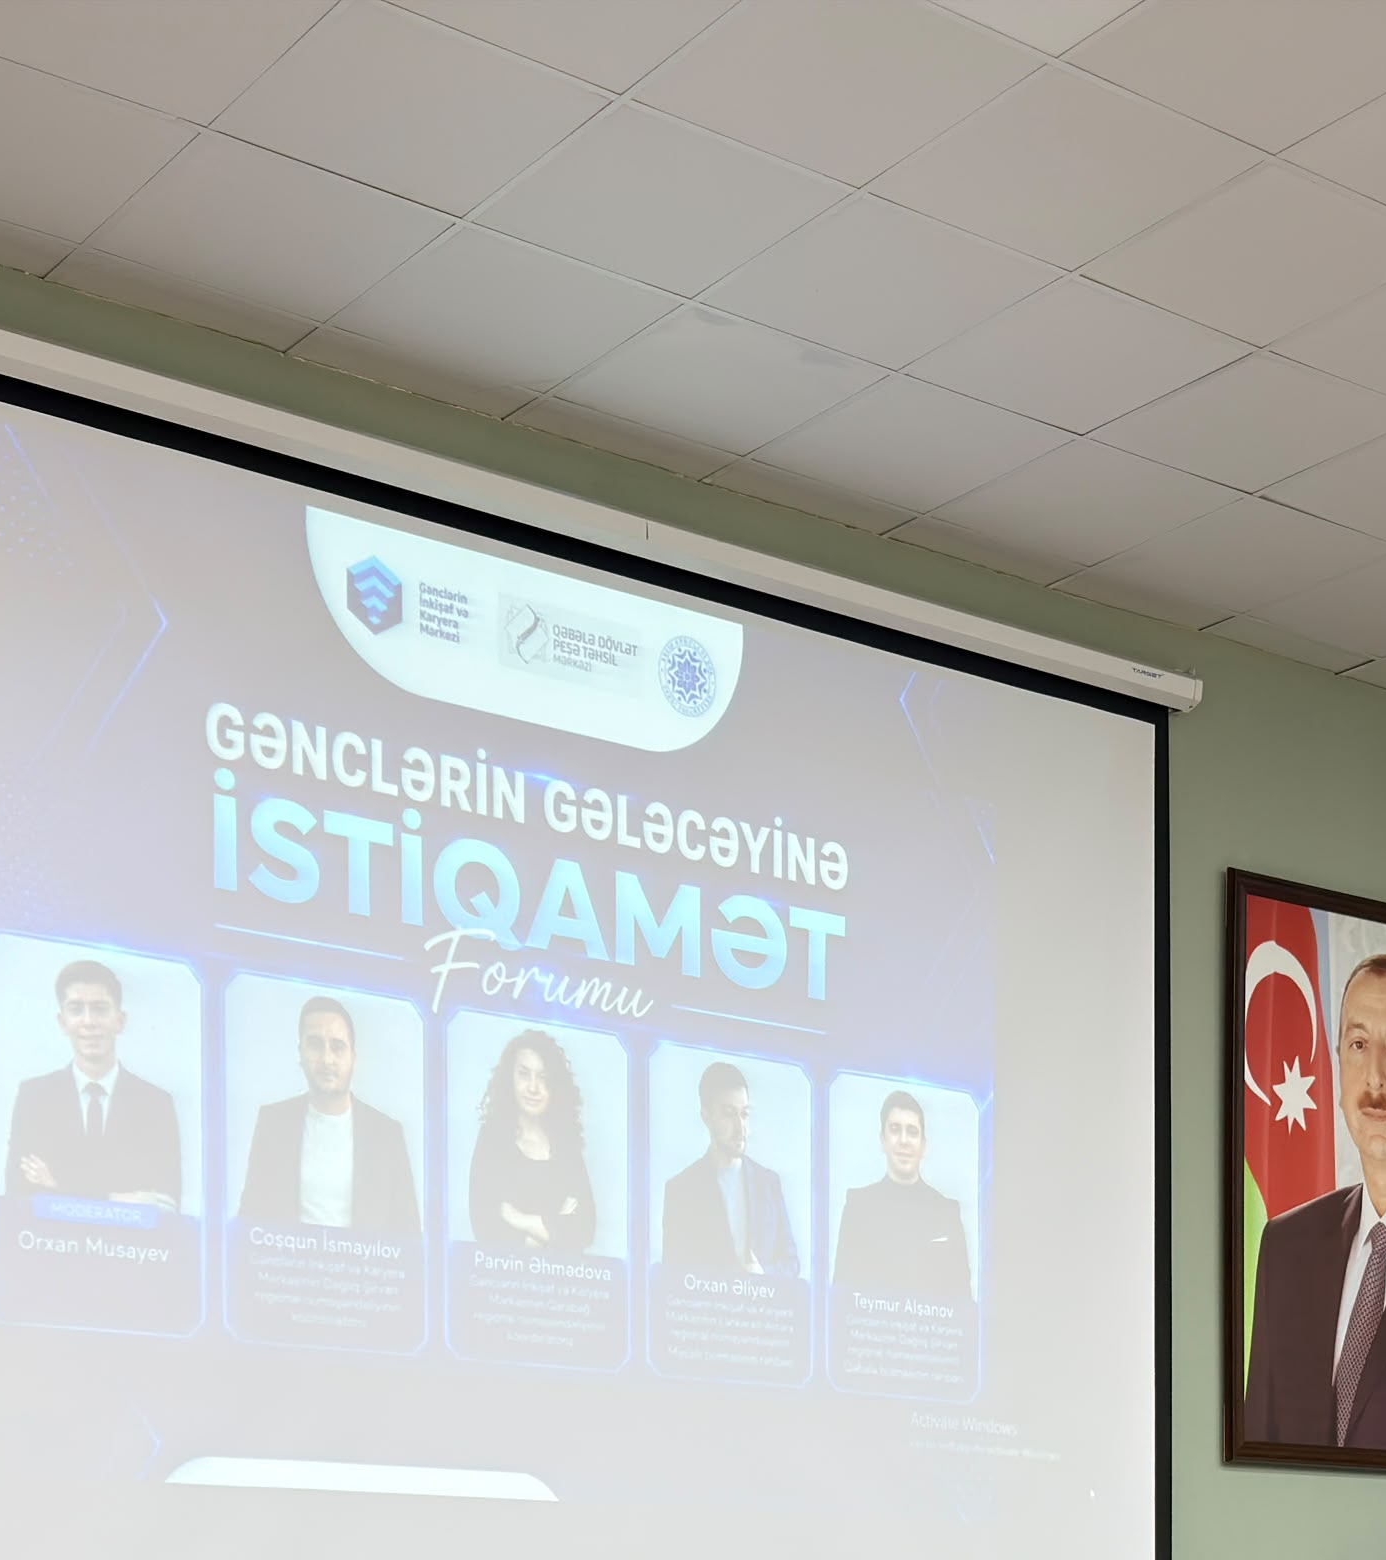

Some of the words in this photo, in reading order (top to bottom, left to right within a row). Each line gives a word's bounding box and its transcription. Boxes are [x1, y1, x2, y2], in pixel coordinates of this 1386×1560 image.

[206, 702, 525, 824] GƏNCLƏRİN
[543, 779, 849, 891] GƏLƏCƏYİNƏ
[213, 767, 846, 1001] İSTİQAMƏT
[423, 927, 654, 1018] Forumu
[50, 1201, 142, 1224] MODERATOR
[18, 1230, 78, 1254] Orxan
[85, 1235, 169, 1264] Musayev
[249, 1226, 317, 1252] Coşqun
[684, 1273, 728, 1294] Orxan
[732, 1279, 776, 1301] Əliyev
[852, 1292, 900, 1313] Teymur
